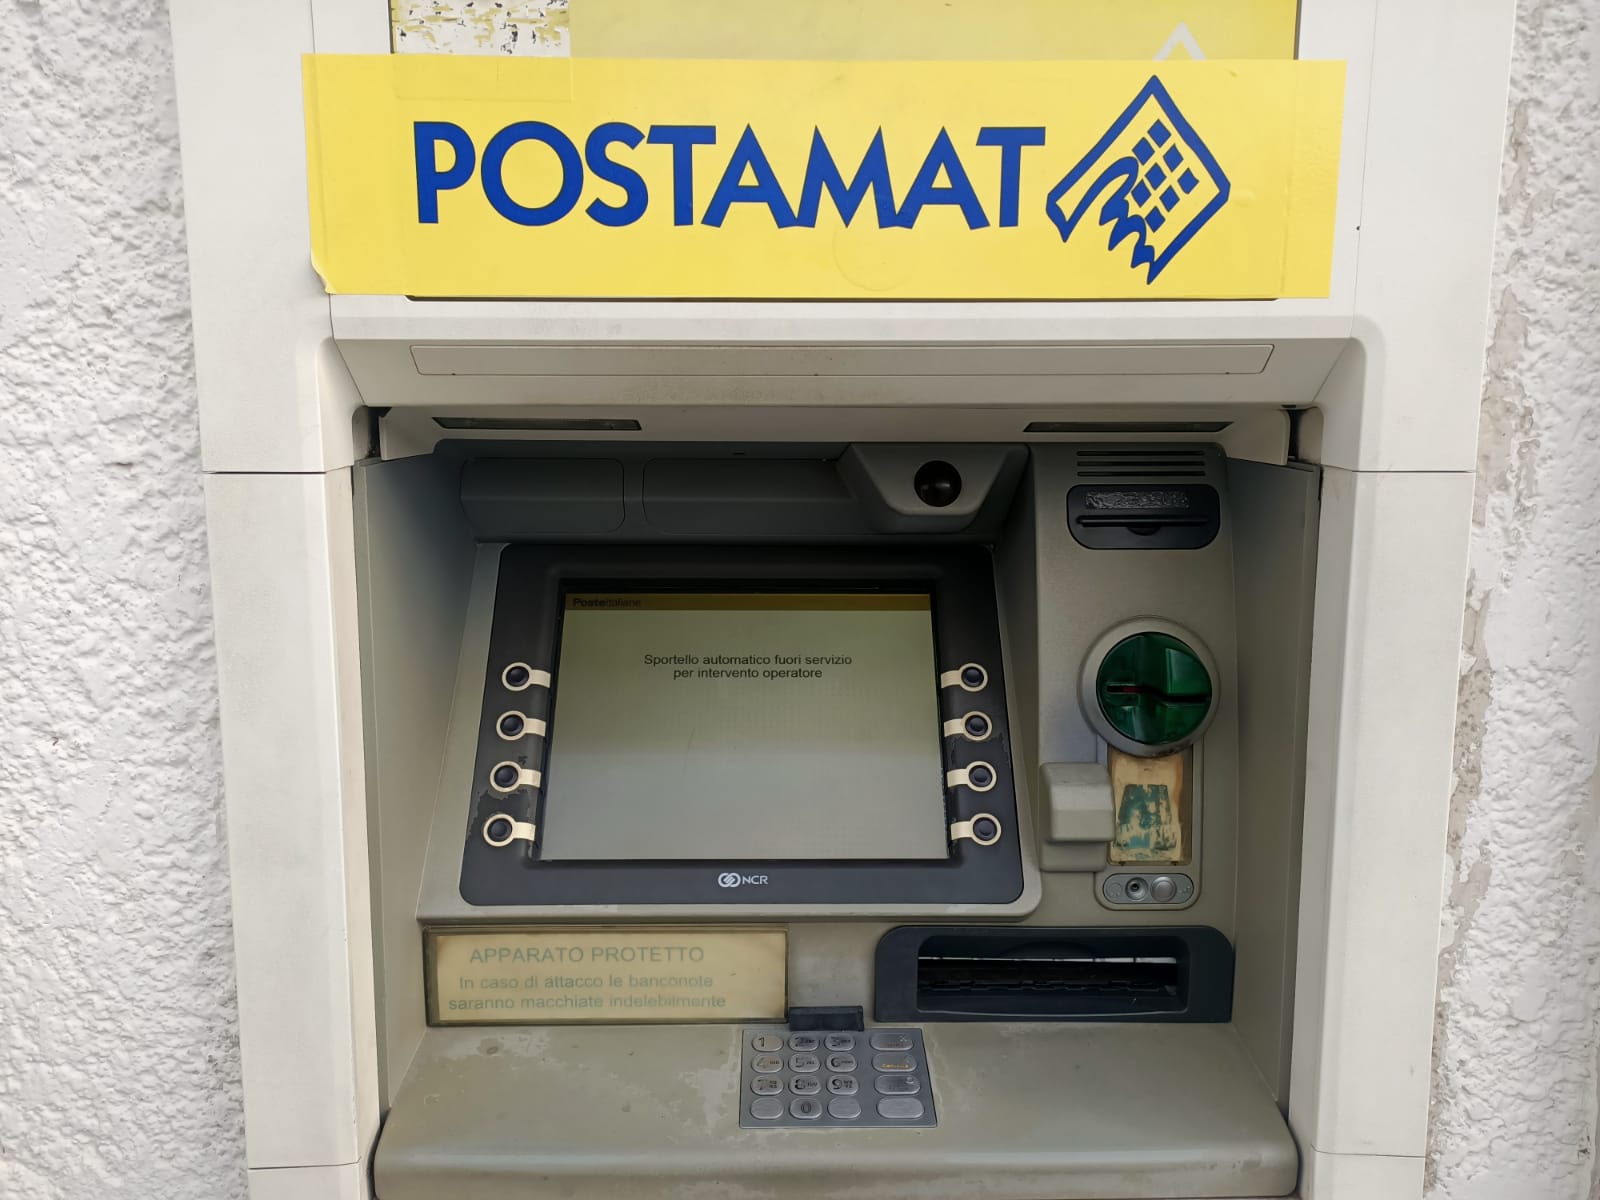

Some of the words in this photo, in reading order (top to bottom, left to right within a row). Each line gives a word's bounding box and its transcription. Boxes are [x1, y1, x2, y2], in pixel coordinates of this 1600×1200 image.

[414, 121, 1046, 230] POSTAMAT
[644, 654, 699, 667] Sportello
[702, 654, 771, 665] automatico
[774, 654, 801, 665] fuori
[805, 654, 852, 665] servizio
[673, 668, 694, 680] per
[697, 668, 759, 678] intervento
[762, 668, 823, 680] operatore
[742, 875, 768, 885] NCR
[470, 947, 585, 963] APPARATO
[591, 946, 705, 962] PROTETTO
[459, 976, 474, 989] In
[480, 976, 519, 989] caso
[524, 975, 538, 989] di
[544, 975, 604, 989] attacco
[609, 974, 623, 988] le
[629, 974, 713, 988] banconote
[448, 997, 515, 1010] saranno
[521, 995, 604, 1009] macchiate
[610, 994, 727, 1008] indelebilmente
